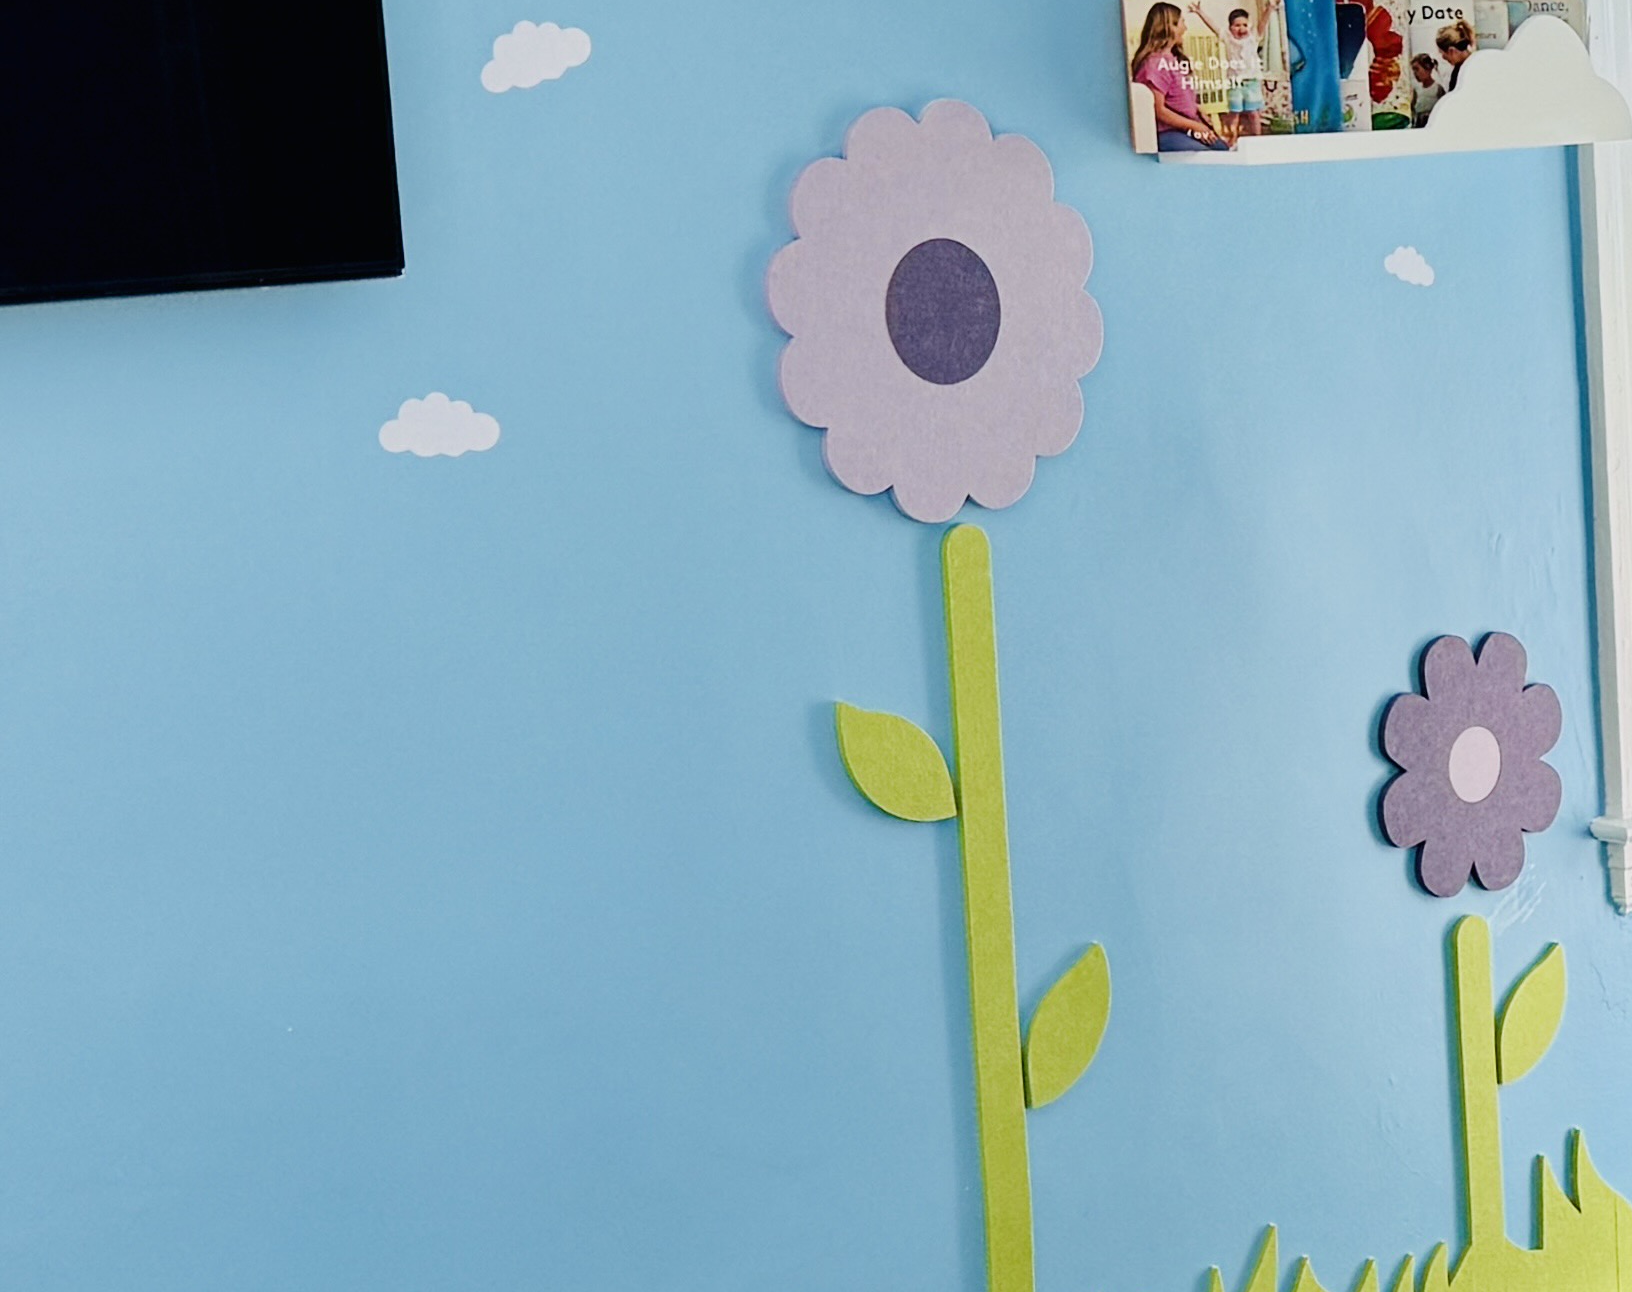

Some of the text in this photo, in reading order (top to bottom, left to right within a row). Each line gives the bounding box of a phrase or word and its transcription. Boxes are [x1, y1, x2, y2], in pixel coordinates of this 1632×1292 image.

[1422, 5, 1463, 20] Date
[1157, 56, 1204, 75] Augie
[1208, 56, 1246, 70] Does
[1181, 75, 1244, 91] Himself
